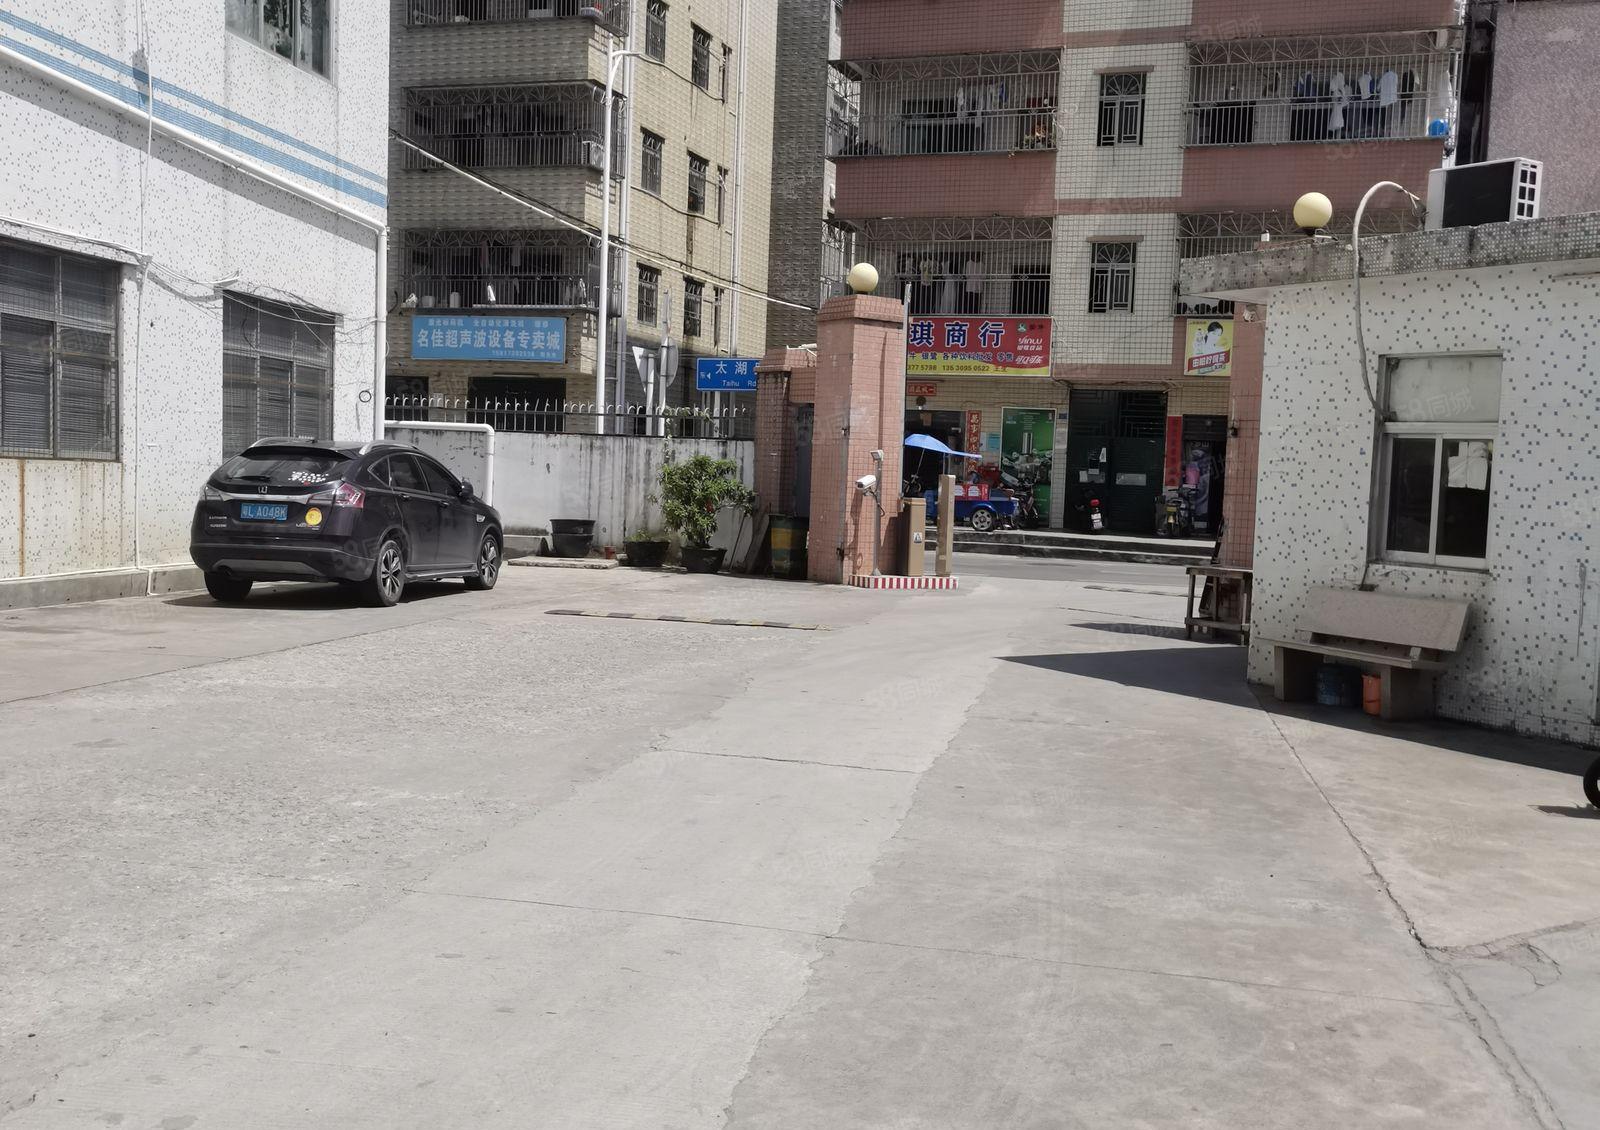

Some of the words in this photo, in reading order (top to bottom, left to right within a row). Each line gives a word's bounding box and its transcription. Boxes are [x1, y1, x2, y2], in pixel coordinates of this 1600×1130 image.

[417, 328, 561, 350] 名佳超声波设备专卖城
